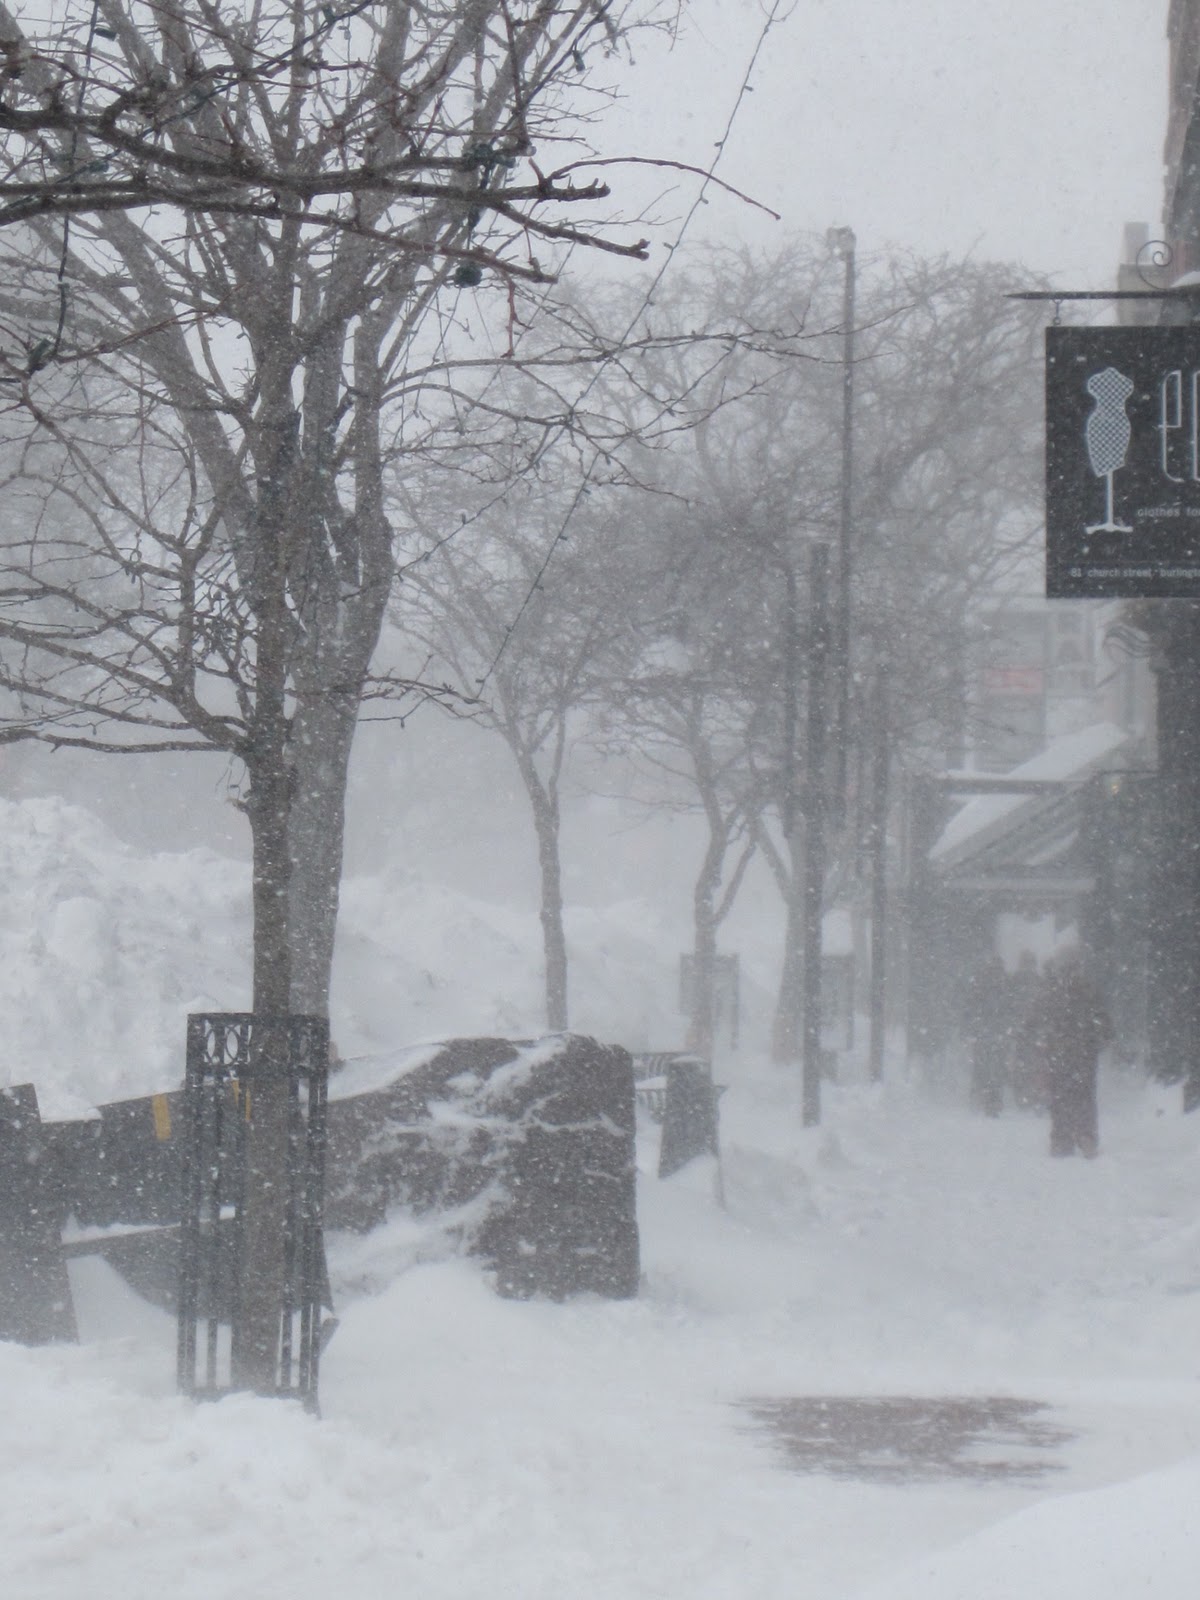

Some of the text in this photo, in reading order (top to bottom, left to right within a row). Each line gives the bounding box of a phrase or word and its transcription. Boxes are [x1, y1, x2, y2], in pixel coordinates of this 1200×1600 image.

[1137, 506, 1200, 517] clothes fo
[1070, 567, 1082, 577] 81
[1087, 567, 1120, 577] church
[1123, 568, 1152, 577] street
